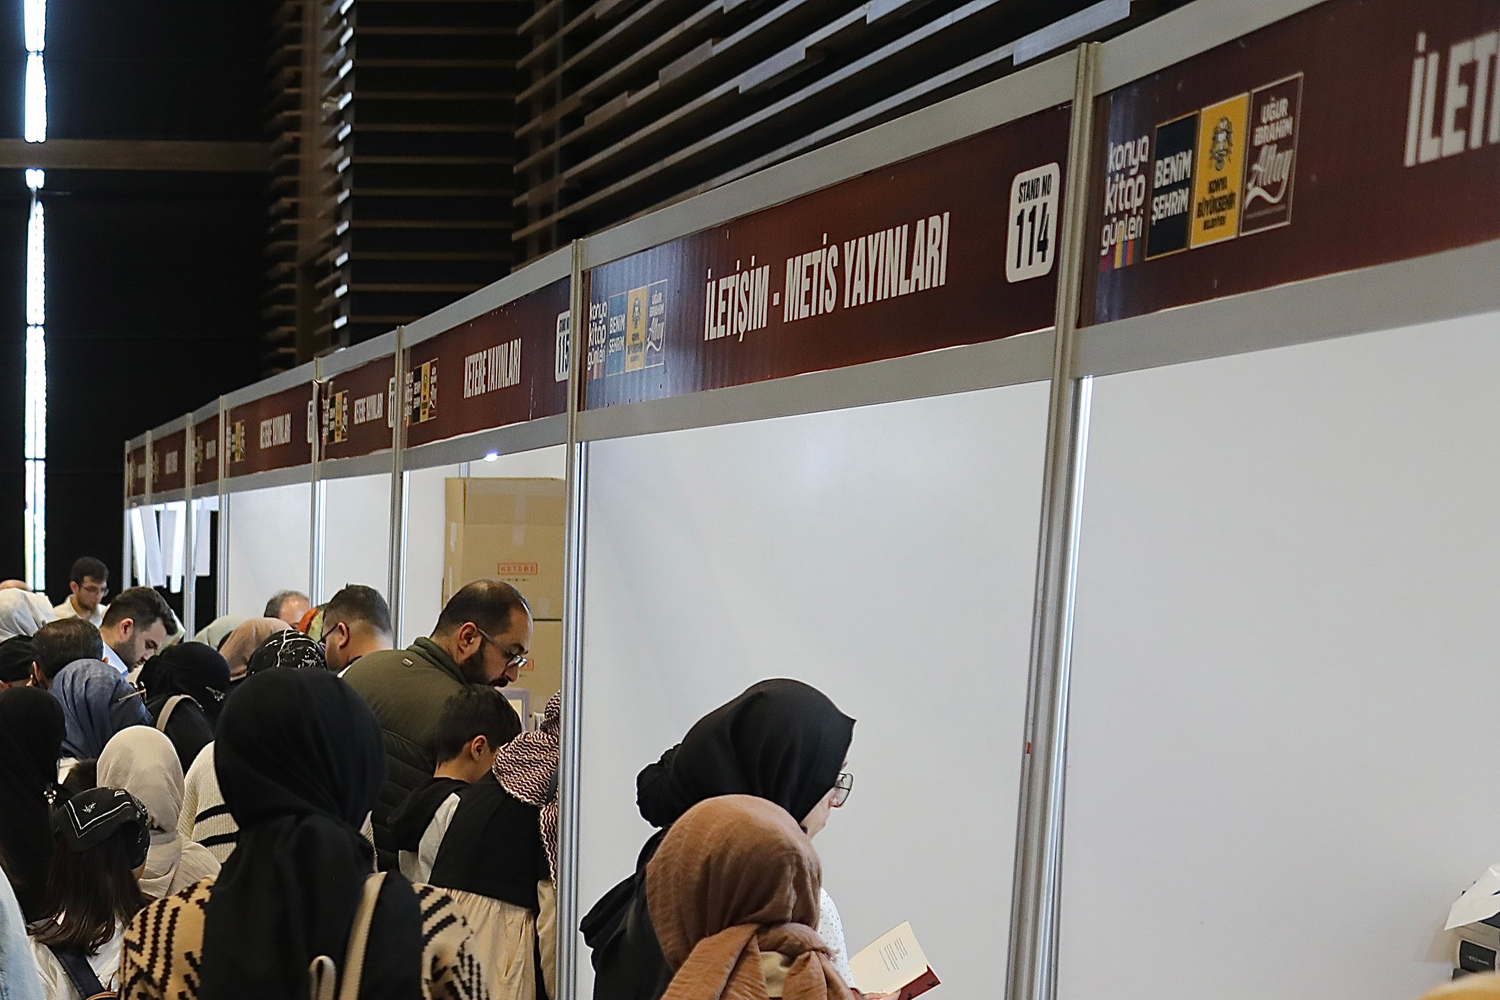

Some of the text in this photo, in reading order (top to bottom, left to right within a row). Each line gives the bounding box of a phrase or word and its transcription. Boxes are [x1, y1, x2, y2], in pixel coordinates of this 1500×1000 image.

[1108, 134, 1149, 176] konya
[1154, 150, 1192, 189] BENİM
[1018, 173, 1052, 204] STAND NO
[1104, 174, 1146, 216] kitap
[1152, 187, 1190, 225] ŞEHRİM
[1016, 202, 1050, 269] 114
[1101, 209, 1143, 256] günleri
[703, 254, 771, 343] İLETİŞİM
[783, 232, 839, 323] METİS
[843, 211, 951, 310] YAYINLARI
[464, 350, 488, 399] KETEBE
[487, 337, 521, 393] YAYINLARI
